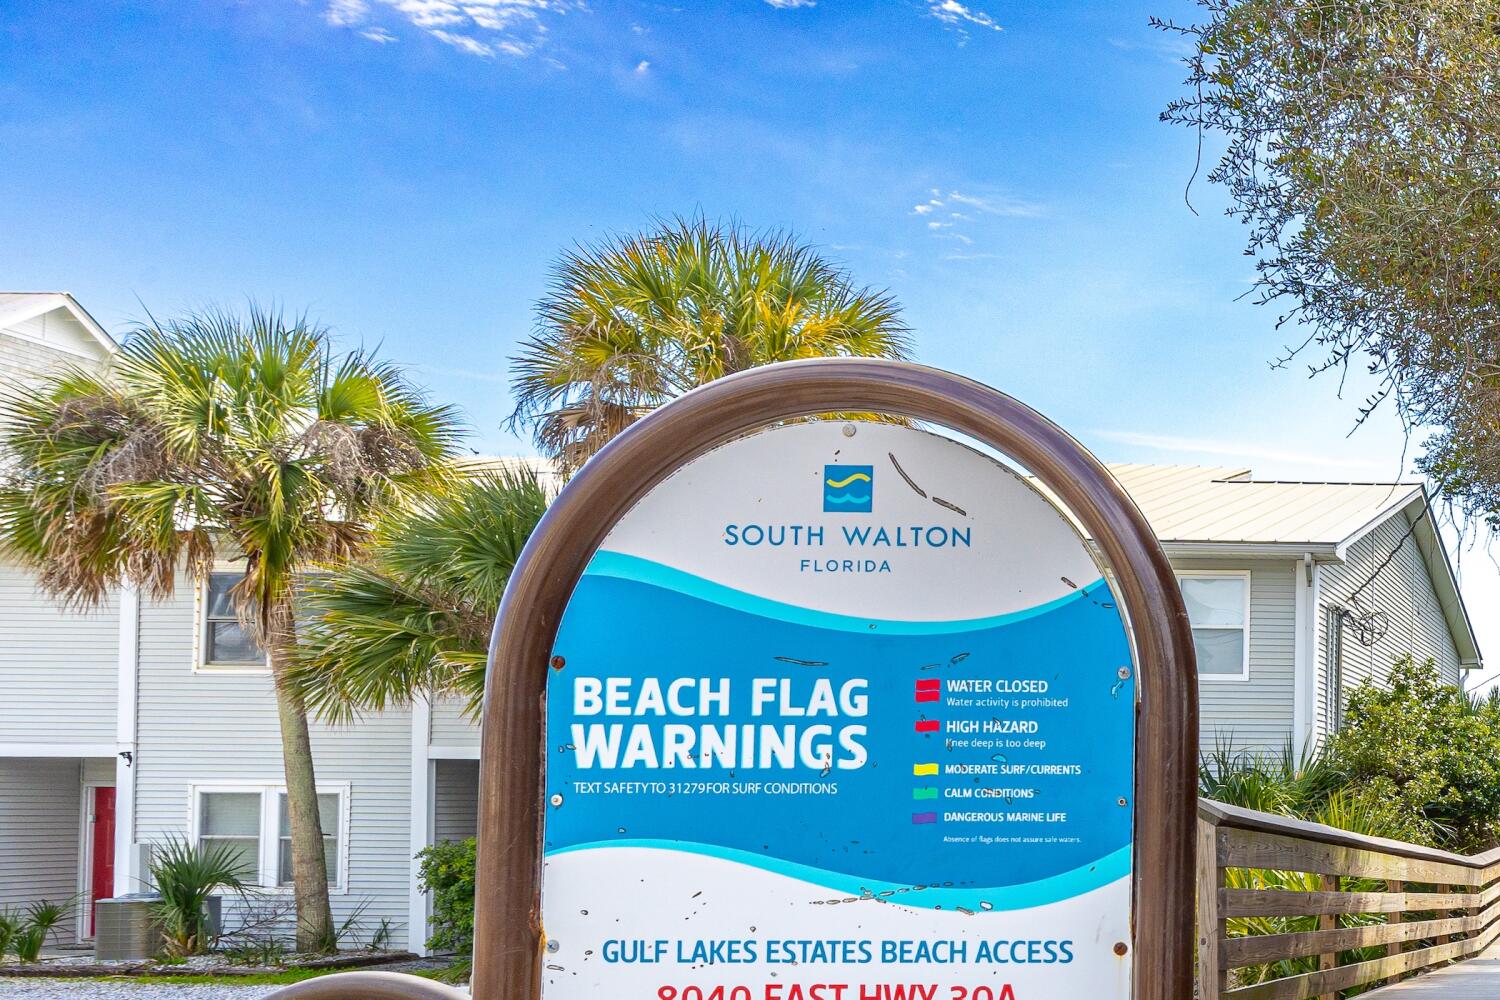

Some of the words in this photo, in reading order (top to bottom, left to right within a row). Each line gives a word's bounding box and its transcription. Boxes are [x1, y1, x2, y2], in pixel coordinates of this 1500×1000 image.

[724, 525, 824, 546] SOUTH
[841, 526, 971, 548] WALTON
[800, 558, 892, 573] FLORIDA
[947, 680, 992, 692] WATER
[995, 680, 1048, 693] CLOSED
[573, 677, 730, 716] BEACH
[751, 678, 869, 717] FLAG
[947, 697, 973, 707] Water
[976, 697, 1009, 708] activity
[1012, 697, 1019, 707] is
[1021, 697, 1068, 708] prohibited
[946, 720, 979, 733] HIGH
[983, 720, 1038, 734] HAZARD
[570, 723, 868, 770] WARNINGS
[945, 738, 968, 748] Knee
[971, 738, 994, 749] deep
[996, 738, 1003, 748] is
[1006, 739, 1021, 748] too
[1024, 738, 1046, 750] deep
[945, 764, 998, 774] MODERATE
[1001, 764, 1081, 775] SURF/CURRENTS
[573, 782, 602, 794] TEXT
[604, 782, 649, 794] SAFETY
[650, 782, 666, 794] TO
[669, 782, 705, 794] 31279
[706, 782, 730, 794] FOR
[732, 782, 762, 795] SURF
[764, 782, 838, 795] CONDITIONS
[944, 788, 972, 798] CALM
[974, 788, 1034, 799] CONDITIONS
[944, 812, 1003, 822] DANGEROUS
[1007, 812, 1044, 823] MARINE
[1046, 813, 1066, 823] LIFE
[602, 940, 668, 963] GULF
[676, 940, 757, 963] LAKES
[765, 940, 872, 963] ESTATES
[880, 940, 968, 963] BEACH
[975, 940, 1074, 963] ACCESS
